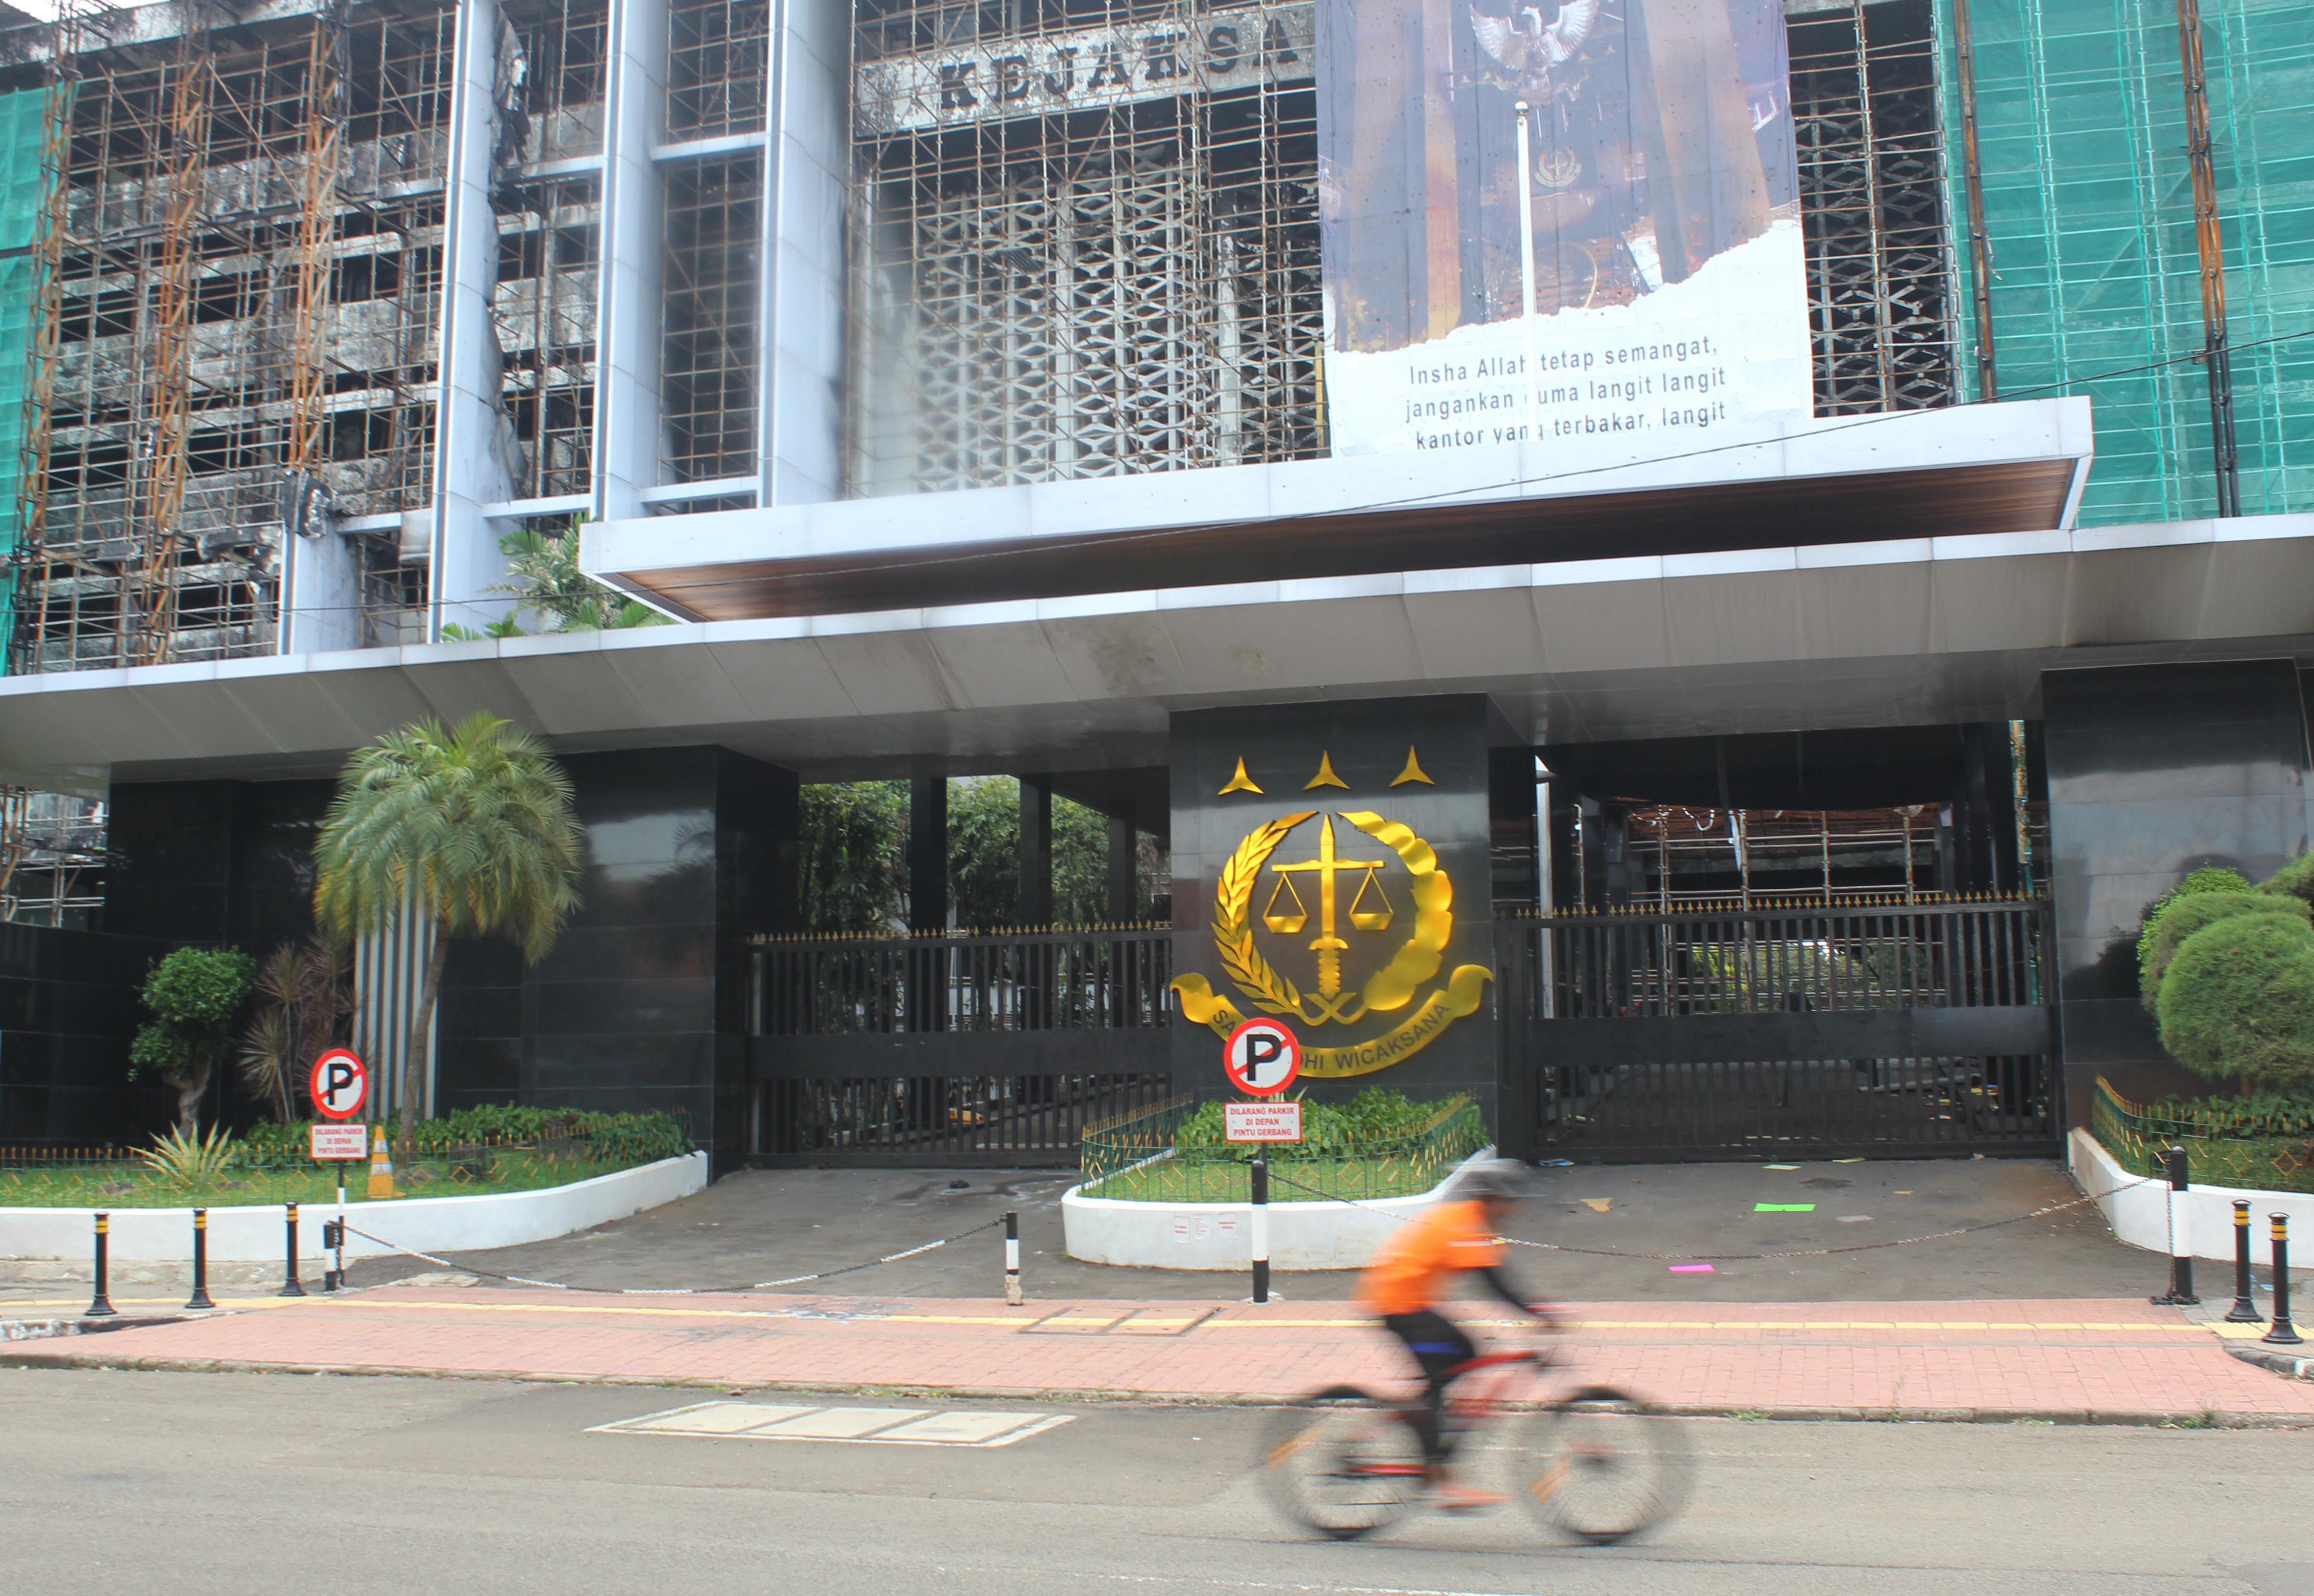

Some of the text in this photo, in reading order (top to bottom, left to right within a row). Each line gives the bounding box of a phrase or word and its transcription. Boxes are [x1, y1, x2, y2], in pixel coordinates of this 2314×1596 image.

[1410, 363, 1467, 385] Insha
[1540, 350, 1593, 371] tetap
[1605, 335, 1717, 365] semangat,
[1405, 367, 1725, 424] jangankan uma langit langit
[1416, 429, 1484, 450] kantor
[1554, 412, 1651, 437] terbakar,
[1662, 401, 1726, 428] langit
[1246, 1033, 1282, 1082] P
[1335, 1003, 1450, 1069] WICAKSANA
[328, 1063, 353, 1105] P
